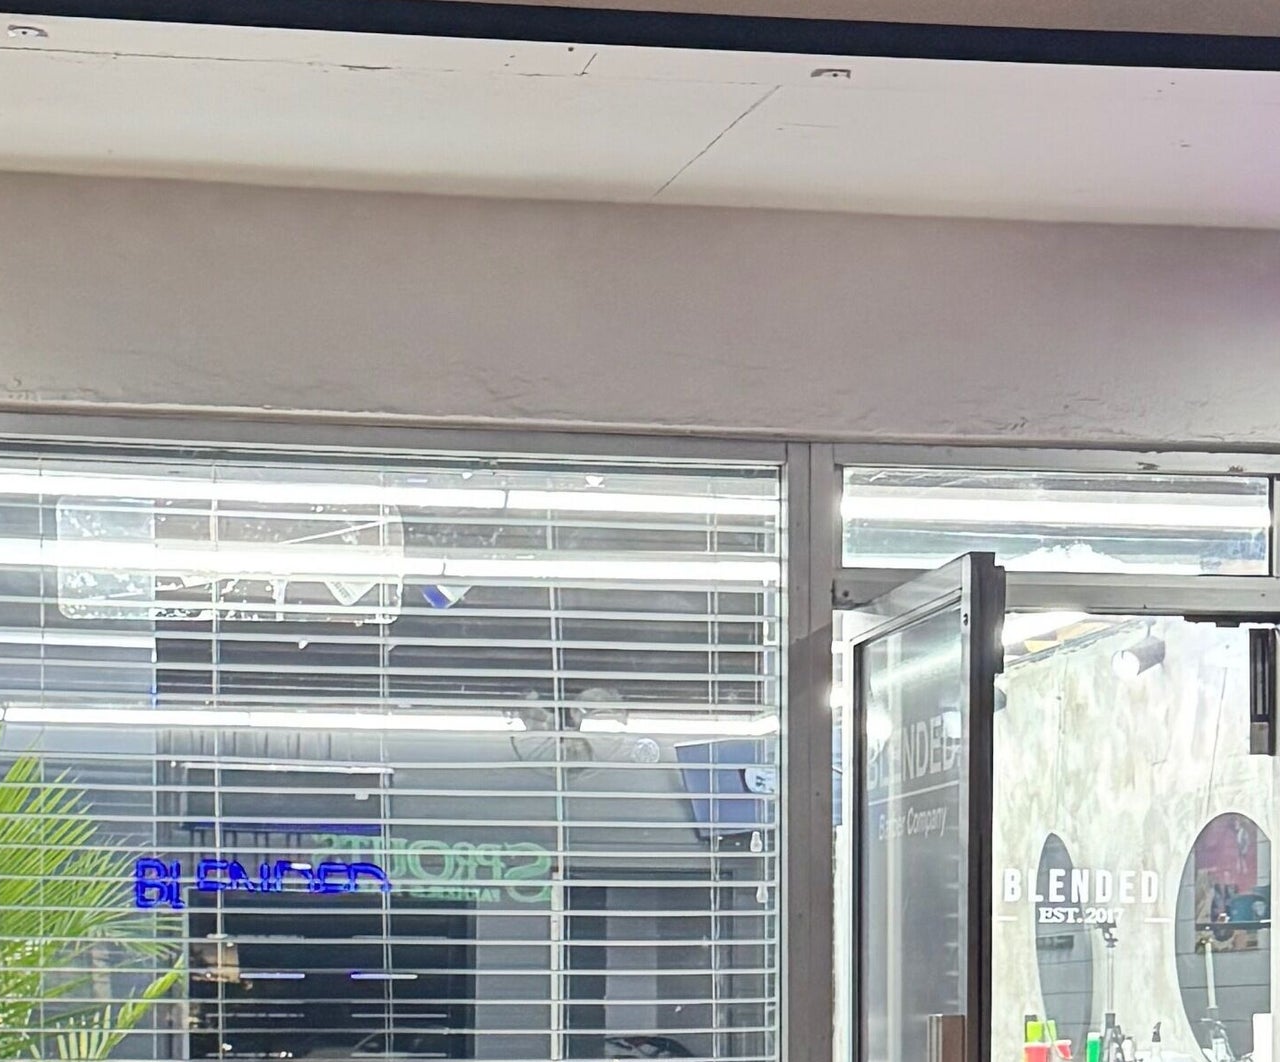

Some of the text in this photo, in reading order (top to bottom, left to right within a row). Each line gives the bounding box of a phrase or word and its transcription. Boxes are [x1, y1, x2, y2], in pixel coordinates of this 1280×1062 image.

[906, 804, 948, 838] Company
[134, 857, 393, 909] BLENDED
[1004, 868, 1160, 904] BLENDED
[1038, 906, 1125, 924] EST.2017
